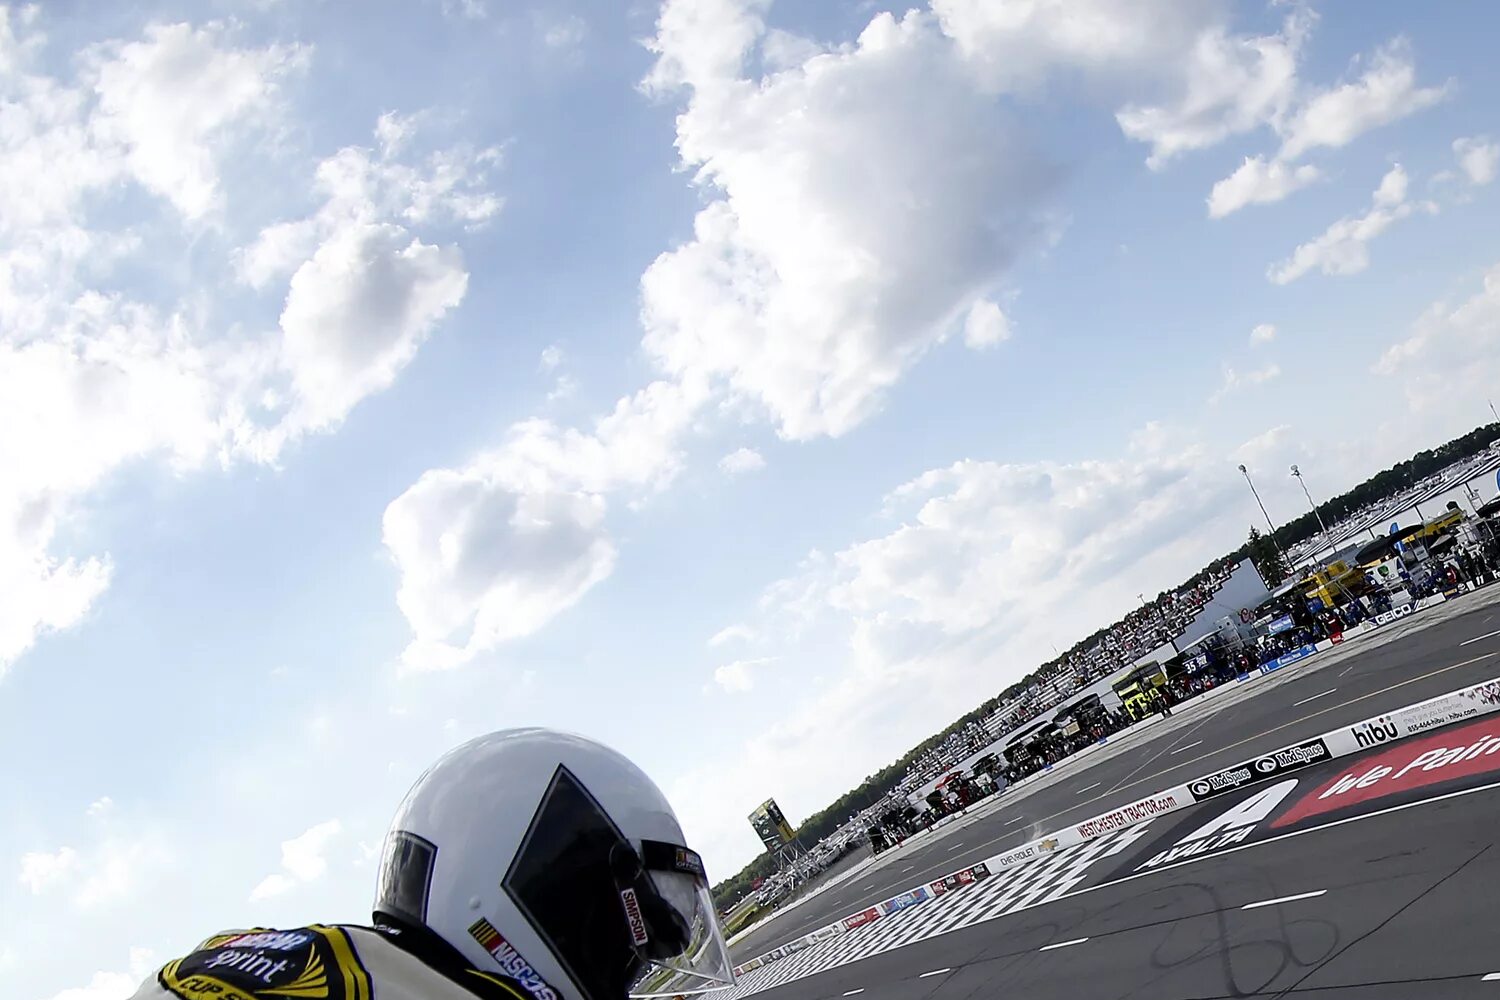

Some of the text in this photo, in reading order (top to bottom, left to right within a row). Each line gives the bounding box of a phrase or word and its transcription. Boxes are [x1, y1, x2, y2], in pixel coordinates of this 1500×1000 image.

[1476, 575, 1485, 586] 11
[1375, 604, 1412, 626] GEICO
[1185, 661, 1197, 674] 35
[1351, 713, 1399, 750] hibu
[1277, 743, 1324, 767] ModSpace
[1209, 767, 1251, 791] ModSpace
[1319, 766, 1393, 800] We
[1076, 796, 1177, 838] WESTCHESTER TRACTOR.com
[1000, 846, 1034, 866] CHEVROLET
[1133, 822, 1257, 872] AXALTA
[624, 892, 646, 942] SIMPSON
[179, 977, 225, 995] CUP
